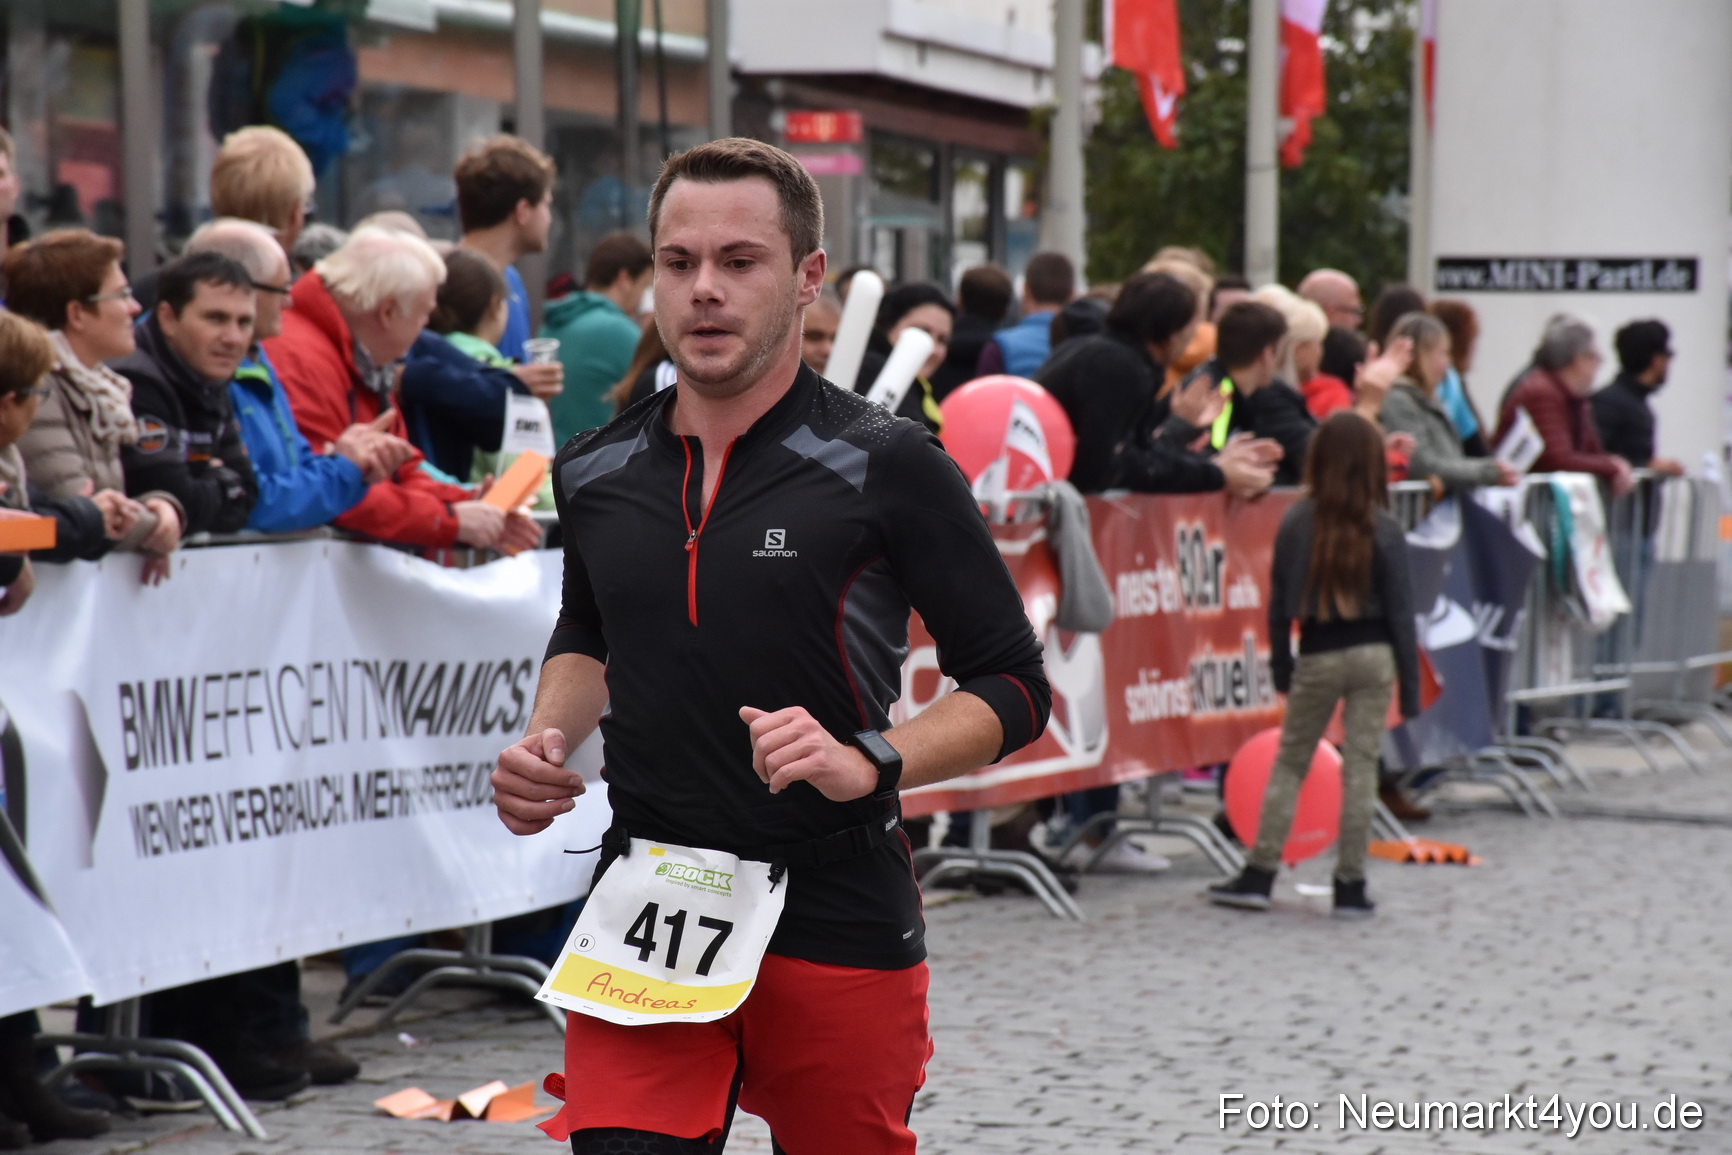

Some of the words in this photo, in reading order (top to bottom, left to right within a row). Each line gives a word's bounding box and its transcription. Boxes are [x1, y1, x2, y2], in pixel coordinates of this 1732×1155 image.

[119, 676, 198, 772] BMW
[129, 794, 218, 859] WENIGER
[668, 863, 734, 891] BOCK
[707, 888, 732, 898] concepts
[623, 901, 734, 977] 417
[586, 971, 698, 1010] Andreas
